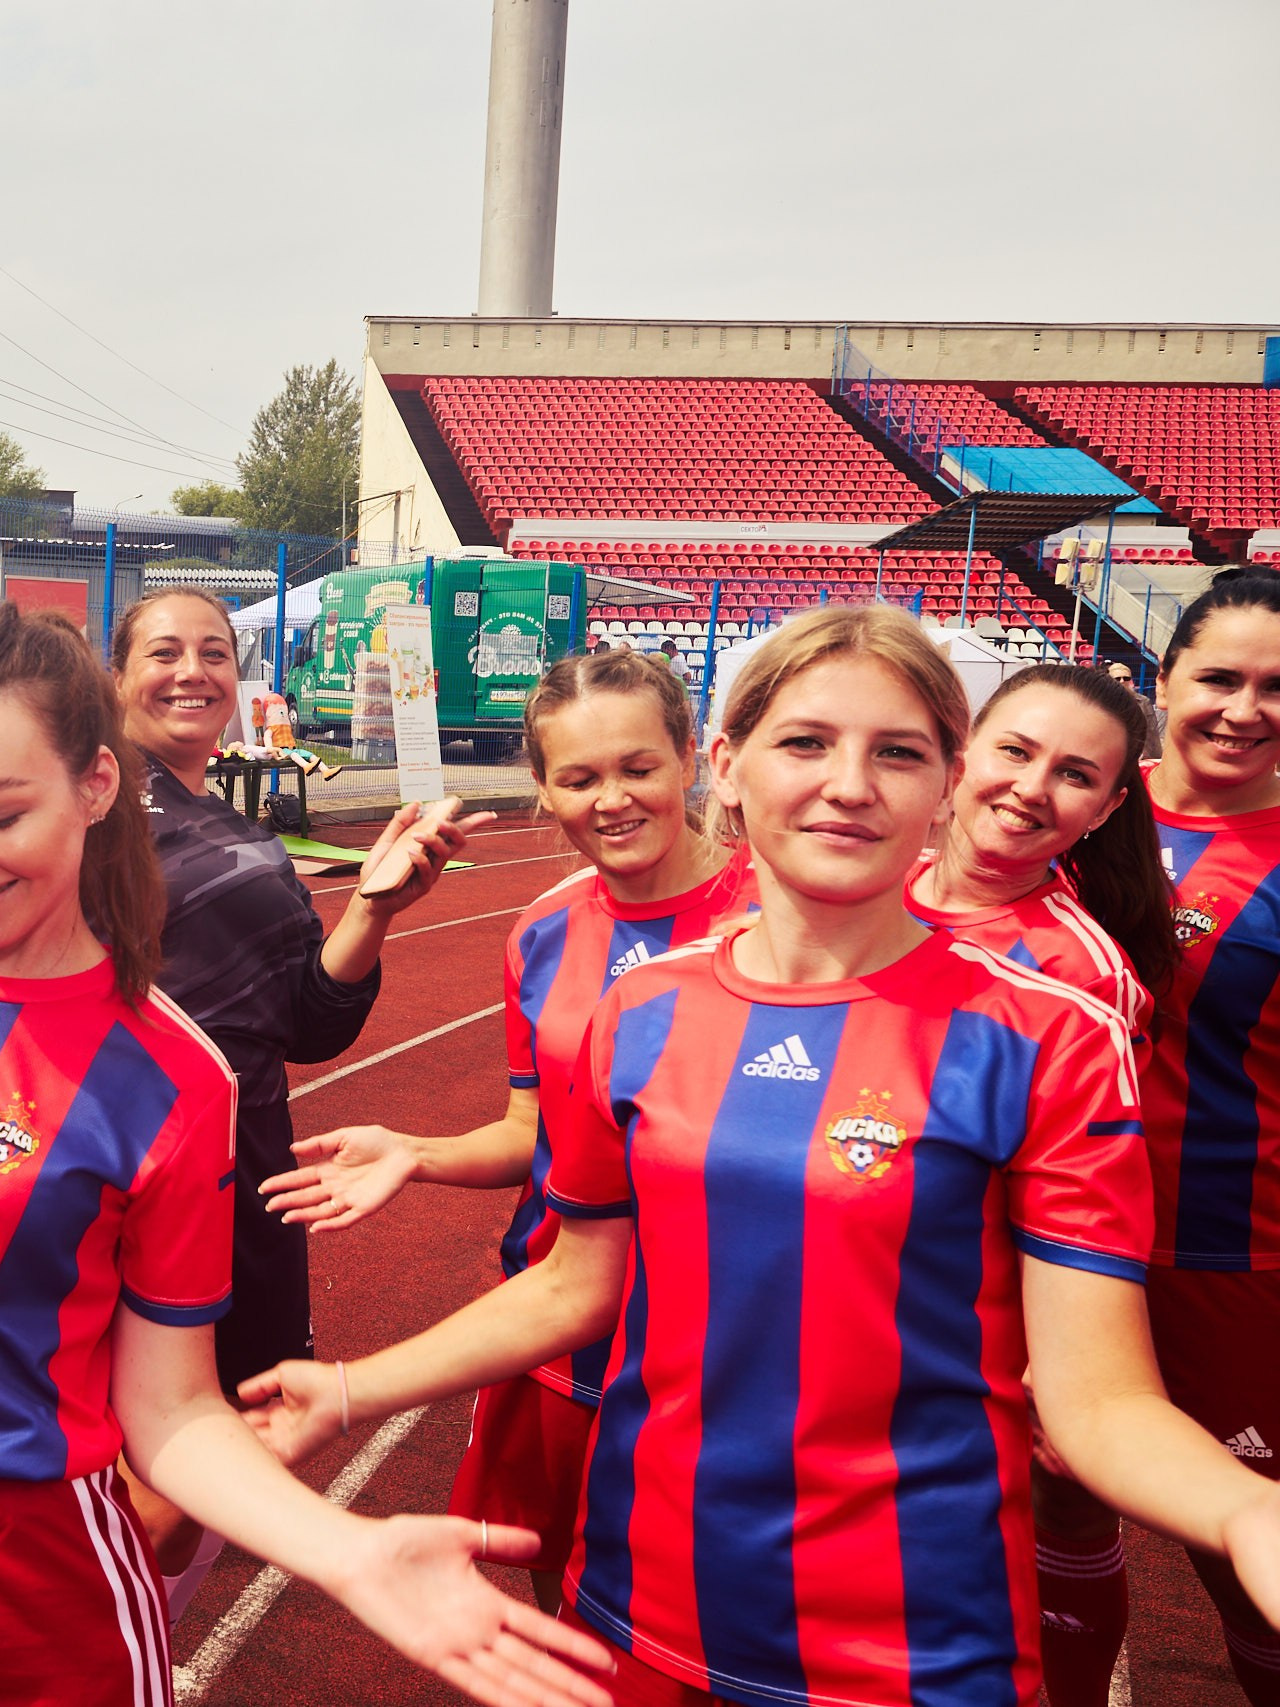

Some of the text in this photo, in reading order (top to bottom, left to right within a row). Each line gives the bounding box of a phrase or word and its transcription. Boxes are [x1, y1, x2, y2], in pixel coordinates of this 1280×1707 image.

[742, 1059, 820, 1082] adidas
[830, 1118, 899, 1148] ЦСКА
[1224, 1444, 1273, 1458] didas
